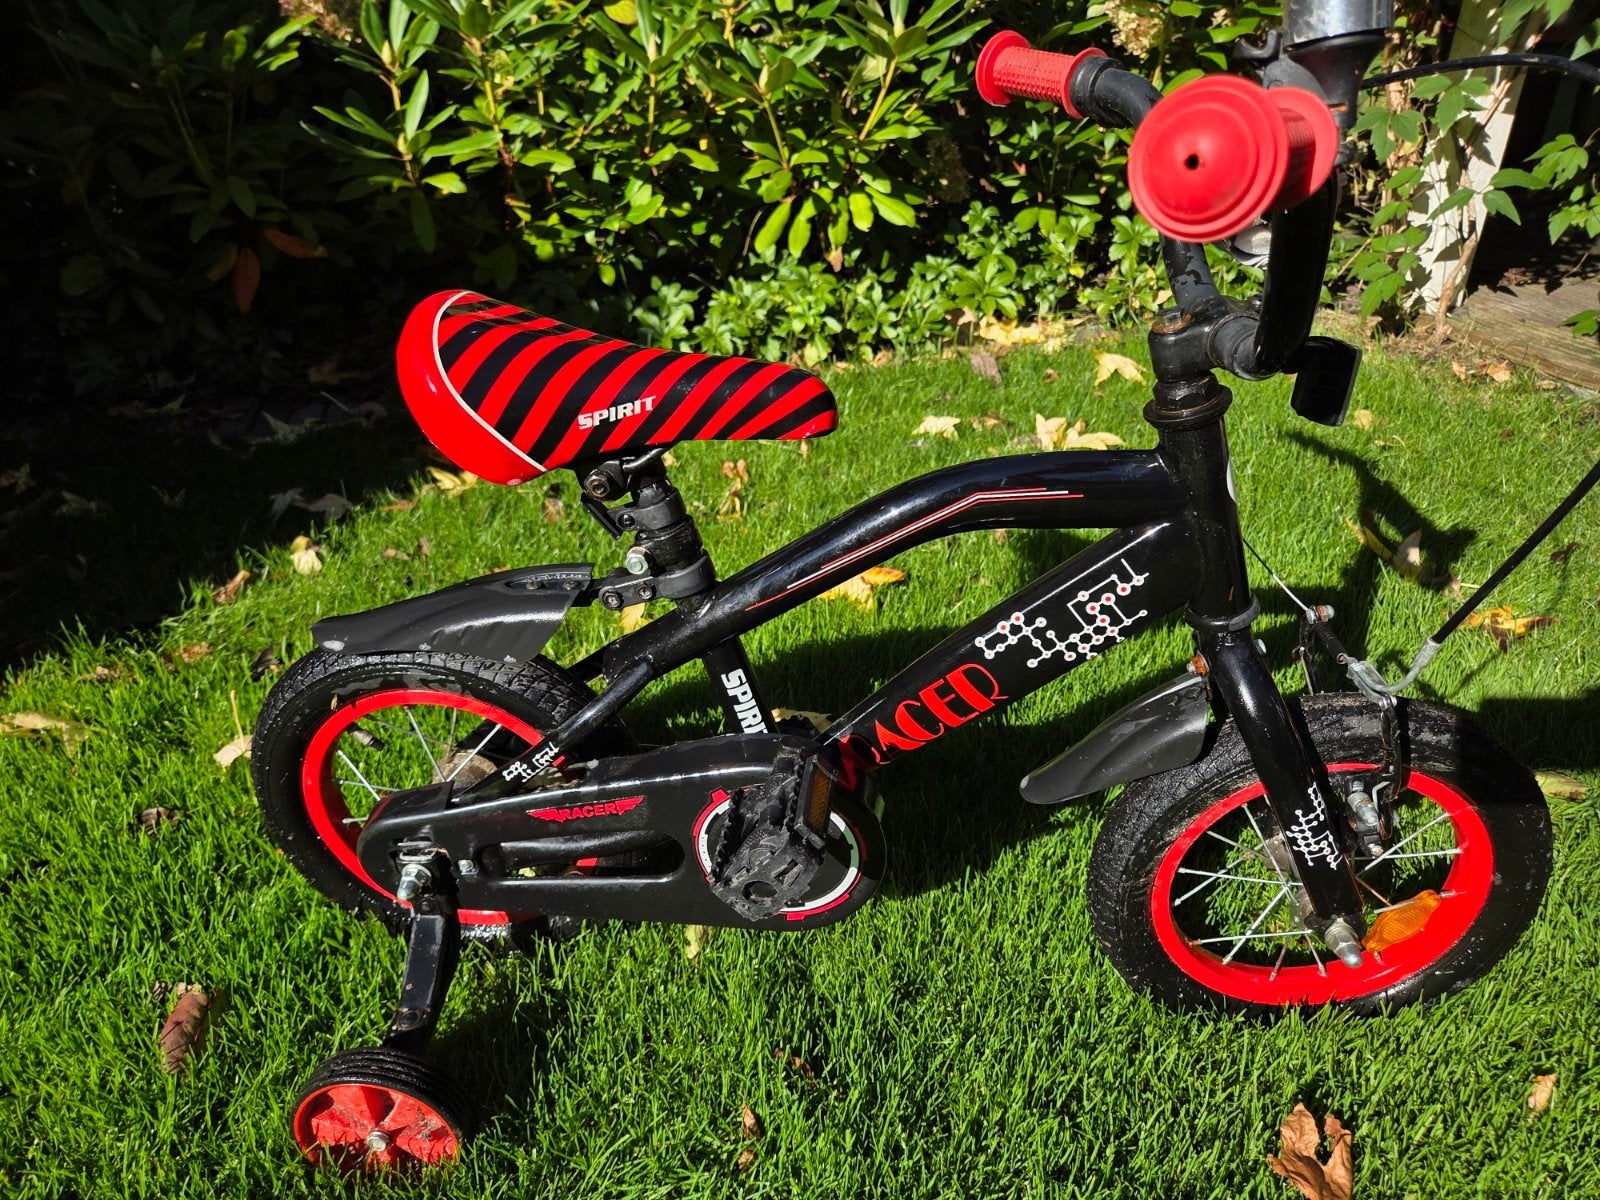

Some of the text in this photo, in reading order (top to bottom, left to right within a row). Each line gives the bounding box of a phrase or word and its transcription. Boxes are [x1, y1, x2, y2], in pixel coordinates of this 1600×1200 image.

[577, 395, 657, 430] SPIRIT
[720, 668, 769, 734] SPIRI
[838, 663, 1009, 768] RACER
[559, 803, 618, 820] RACER
